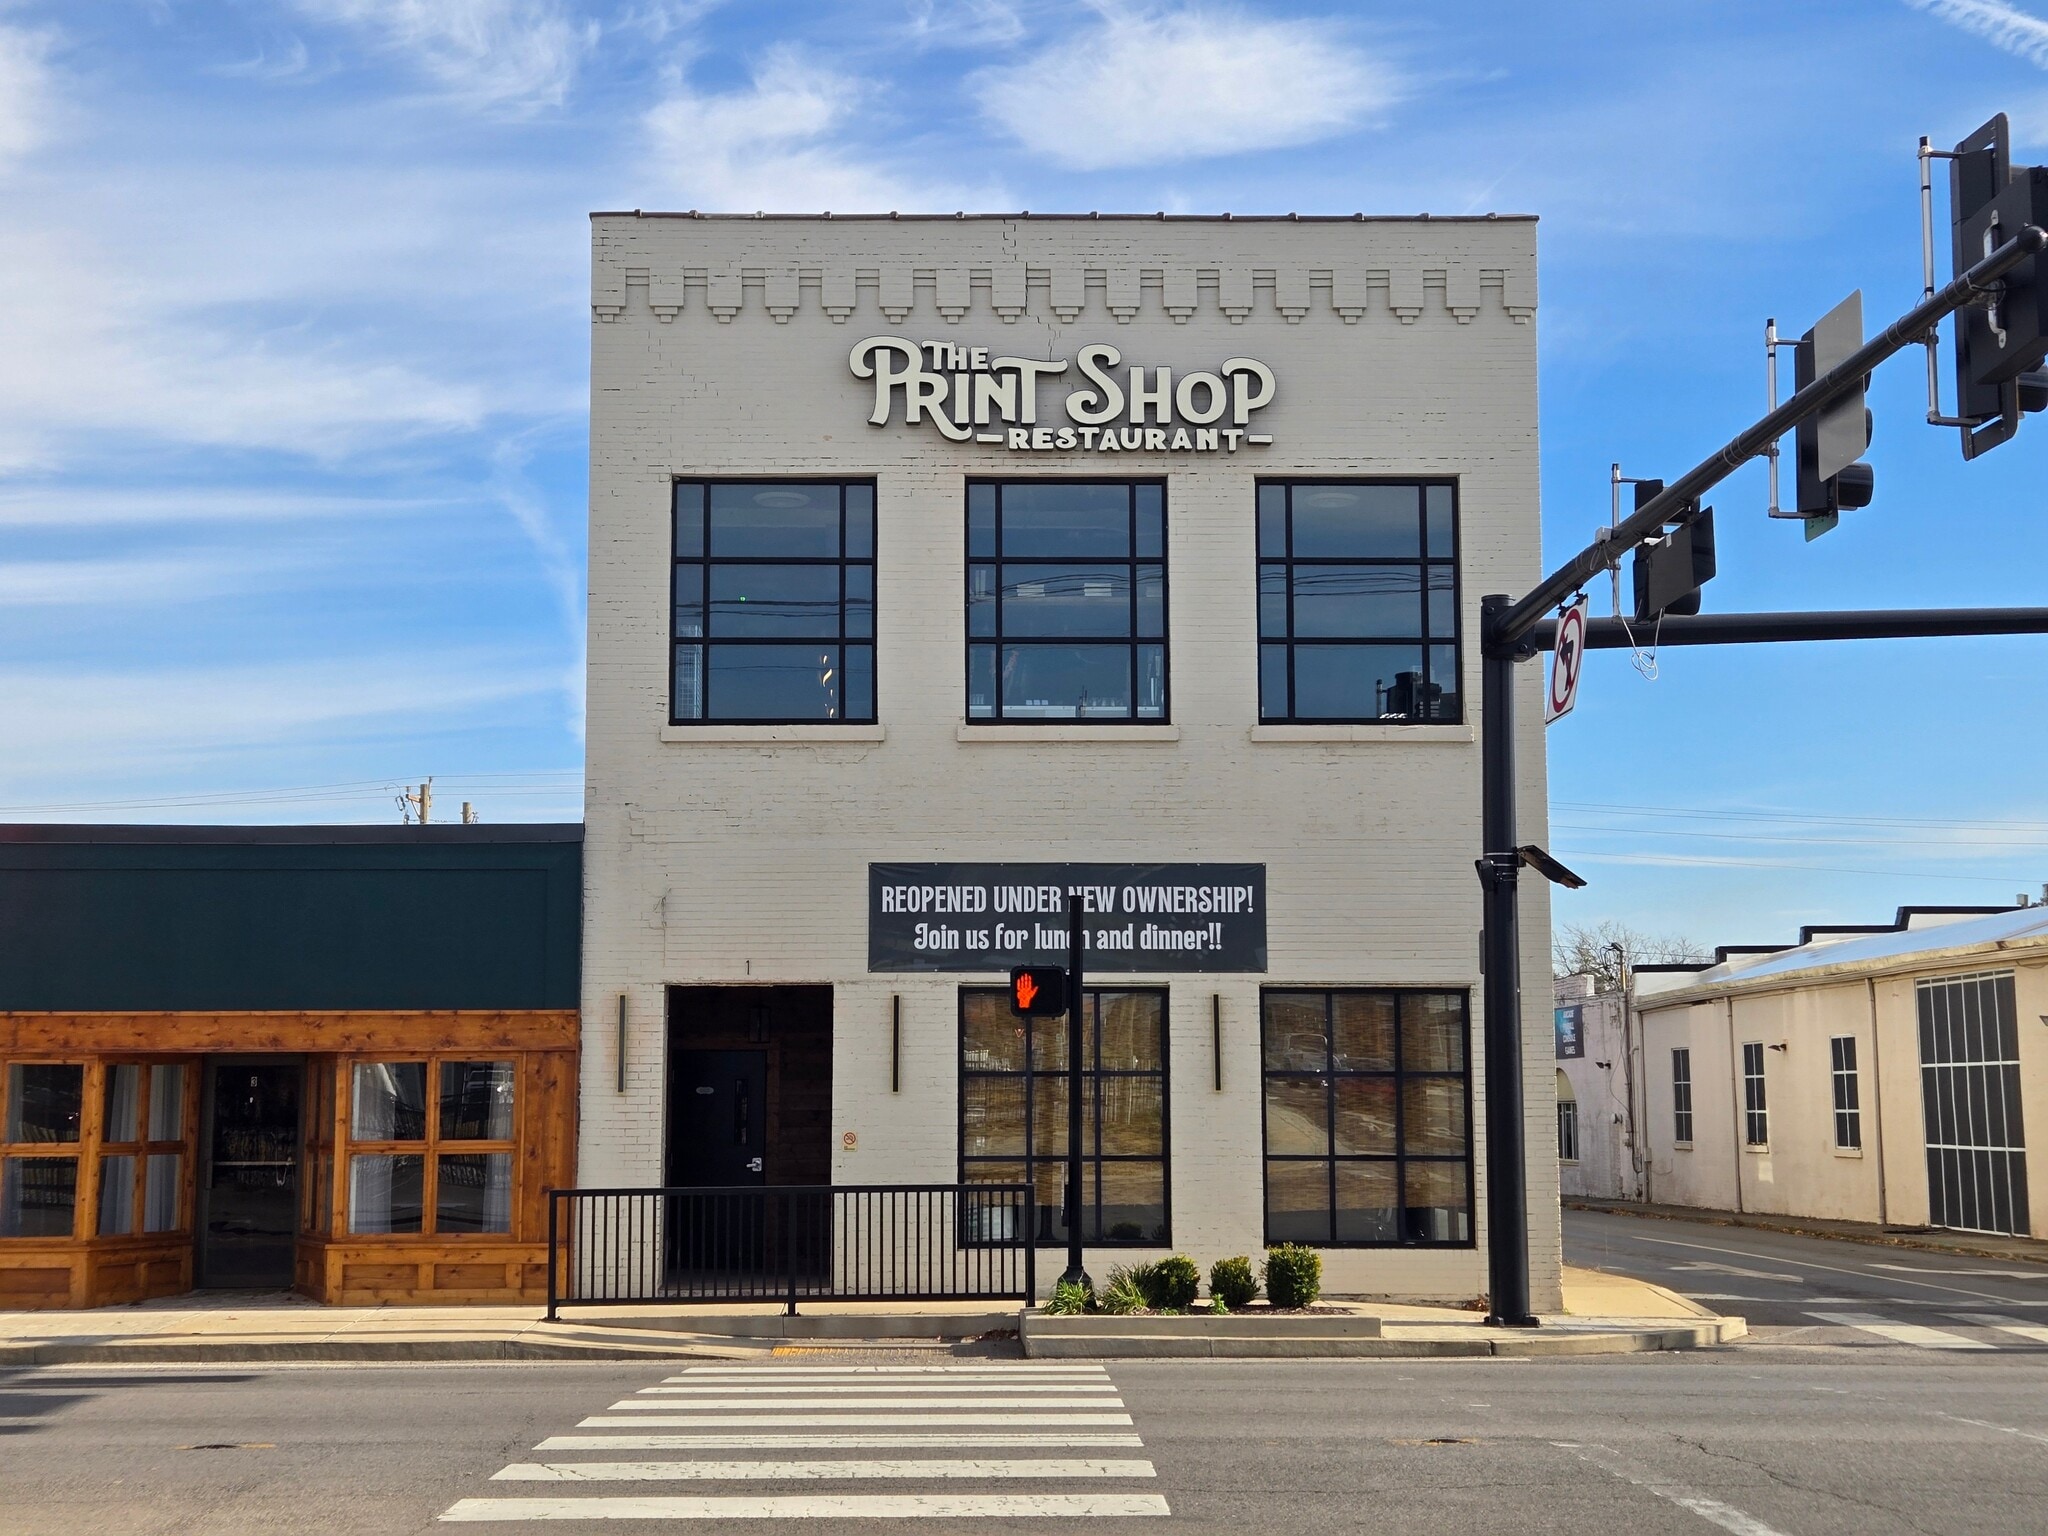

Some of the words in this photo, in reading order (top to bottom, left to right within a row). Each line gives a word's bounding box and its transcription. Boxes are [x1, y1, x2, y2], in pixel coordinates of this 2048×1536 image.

[921, 340, 989, 370] THE
[849, 335, 1068, 441] PRINT
[1065, 343, 1276, 425] SHOP
[1008, 427, 1244, 451] RESTAURANT
[881, 885, 987, 913] REOPENED
[993, 885, 1062, 913] UNDER
[1122, 885, 1254, 913] OWNERSHIP!
[913, 922, 960, 950] Join
[965, 929, 990, 950] us
[995, 922, 1029, 950] for
[1034, 922, 1091, 950] lun
[1096, 923, 1134, 950] and
[1139, 922, 1222, 950] dinner!!
